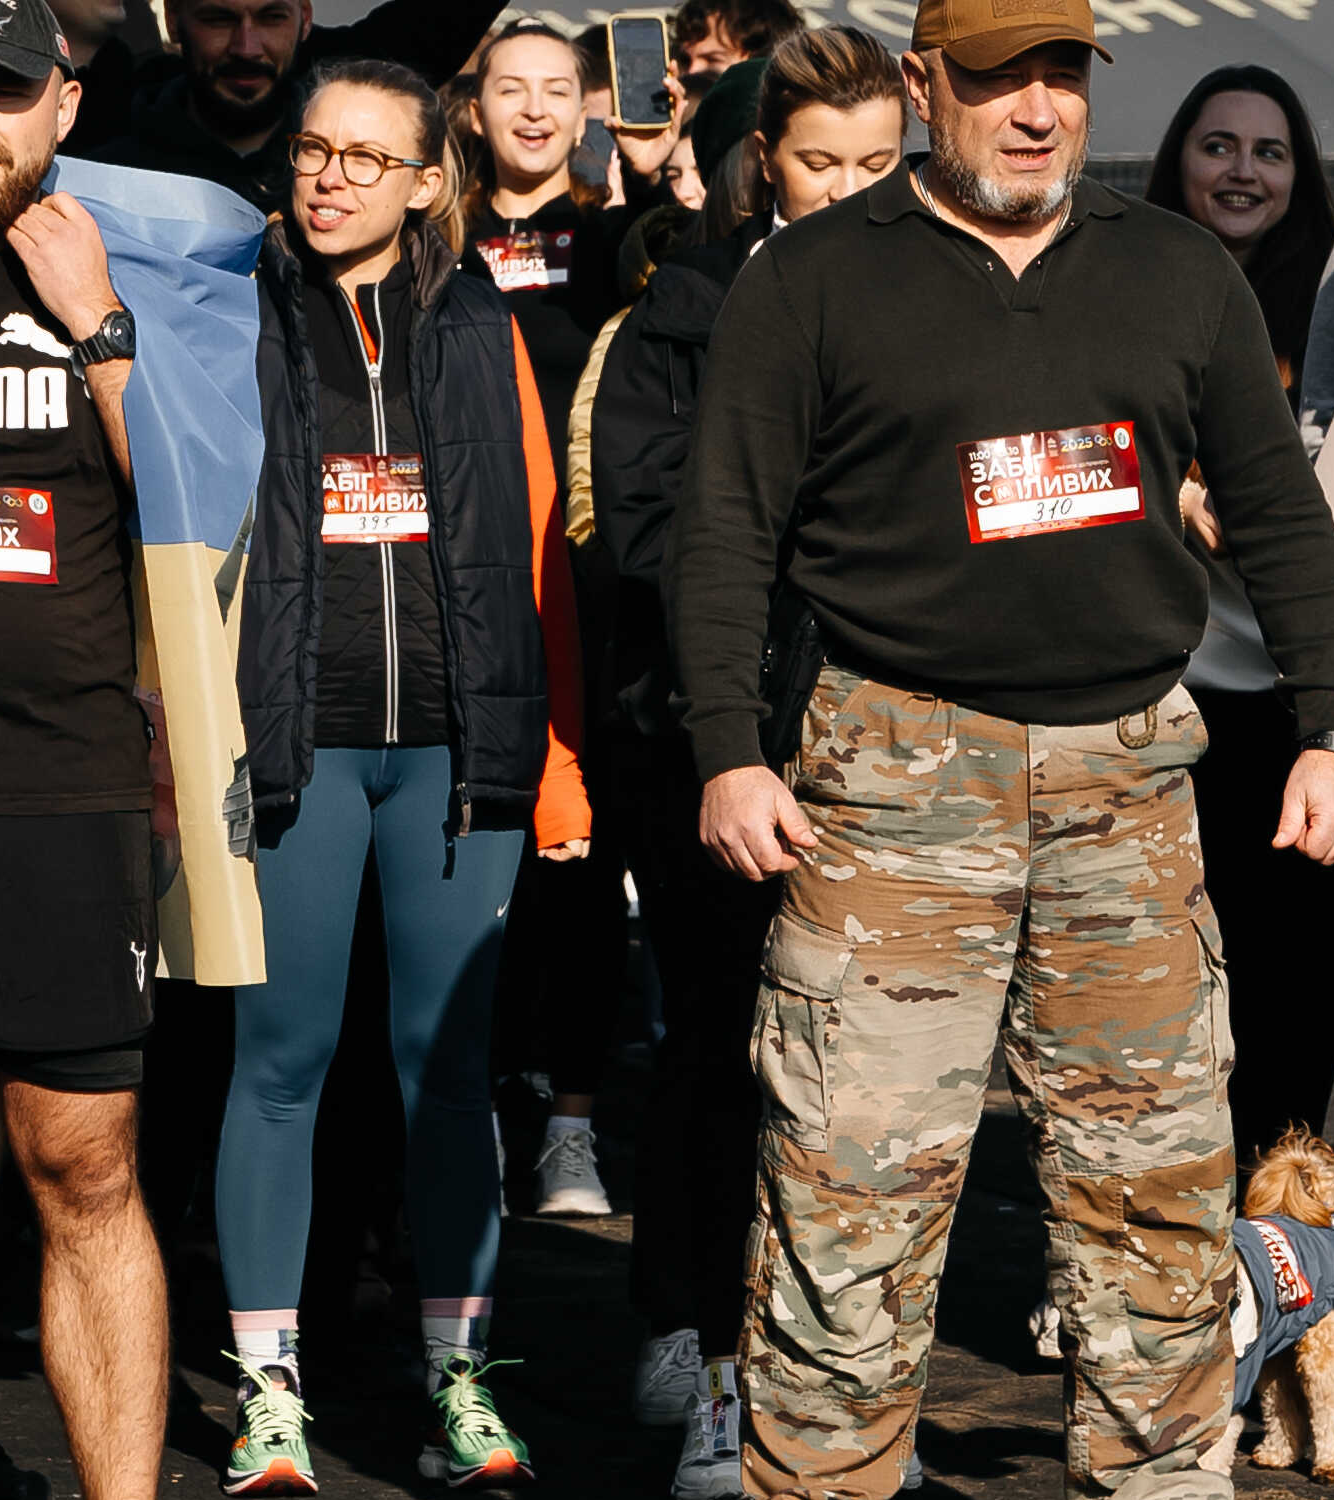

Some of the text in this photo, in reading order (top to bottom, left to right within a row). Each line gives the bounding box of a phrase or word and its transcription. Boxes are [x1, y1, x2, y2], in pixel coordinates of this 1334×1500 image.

[1060, 436, 1094, 453] 2025
[389, 463, 420, 475] 2025
[323, 472, 375, 492] АБІГ
